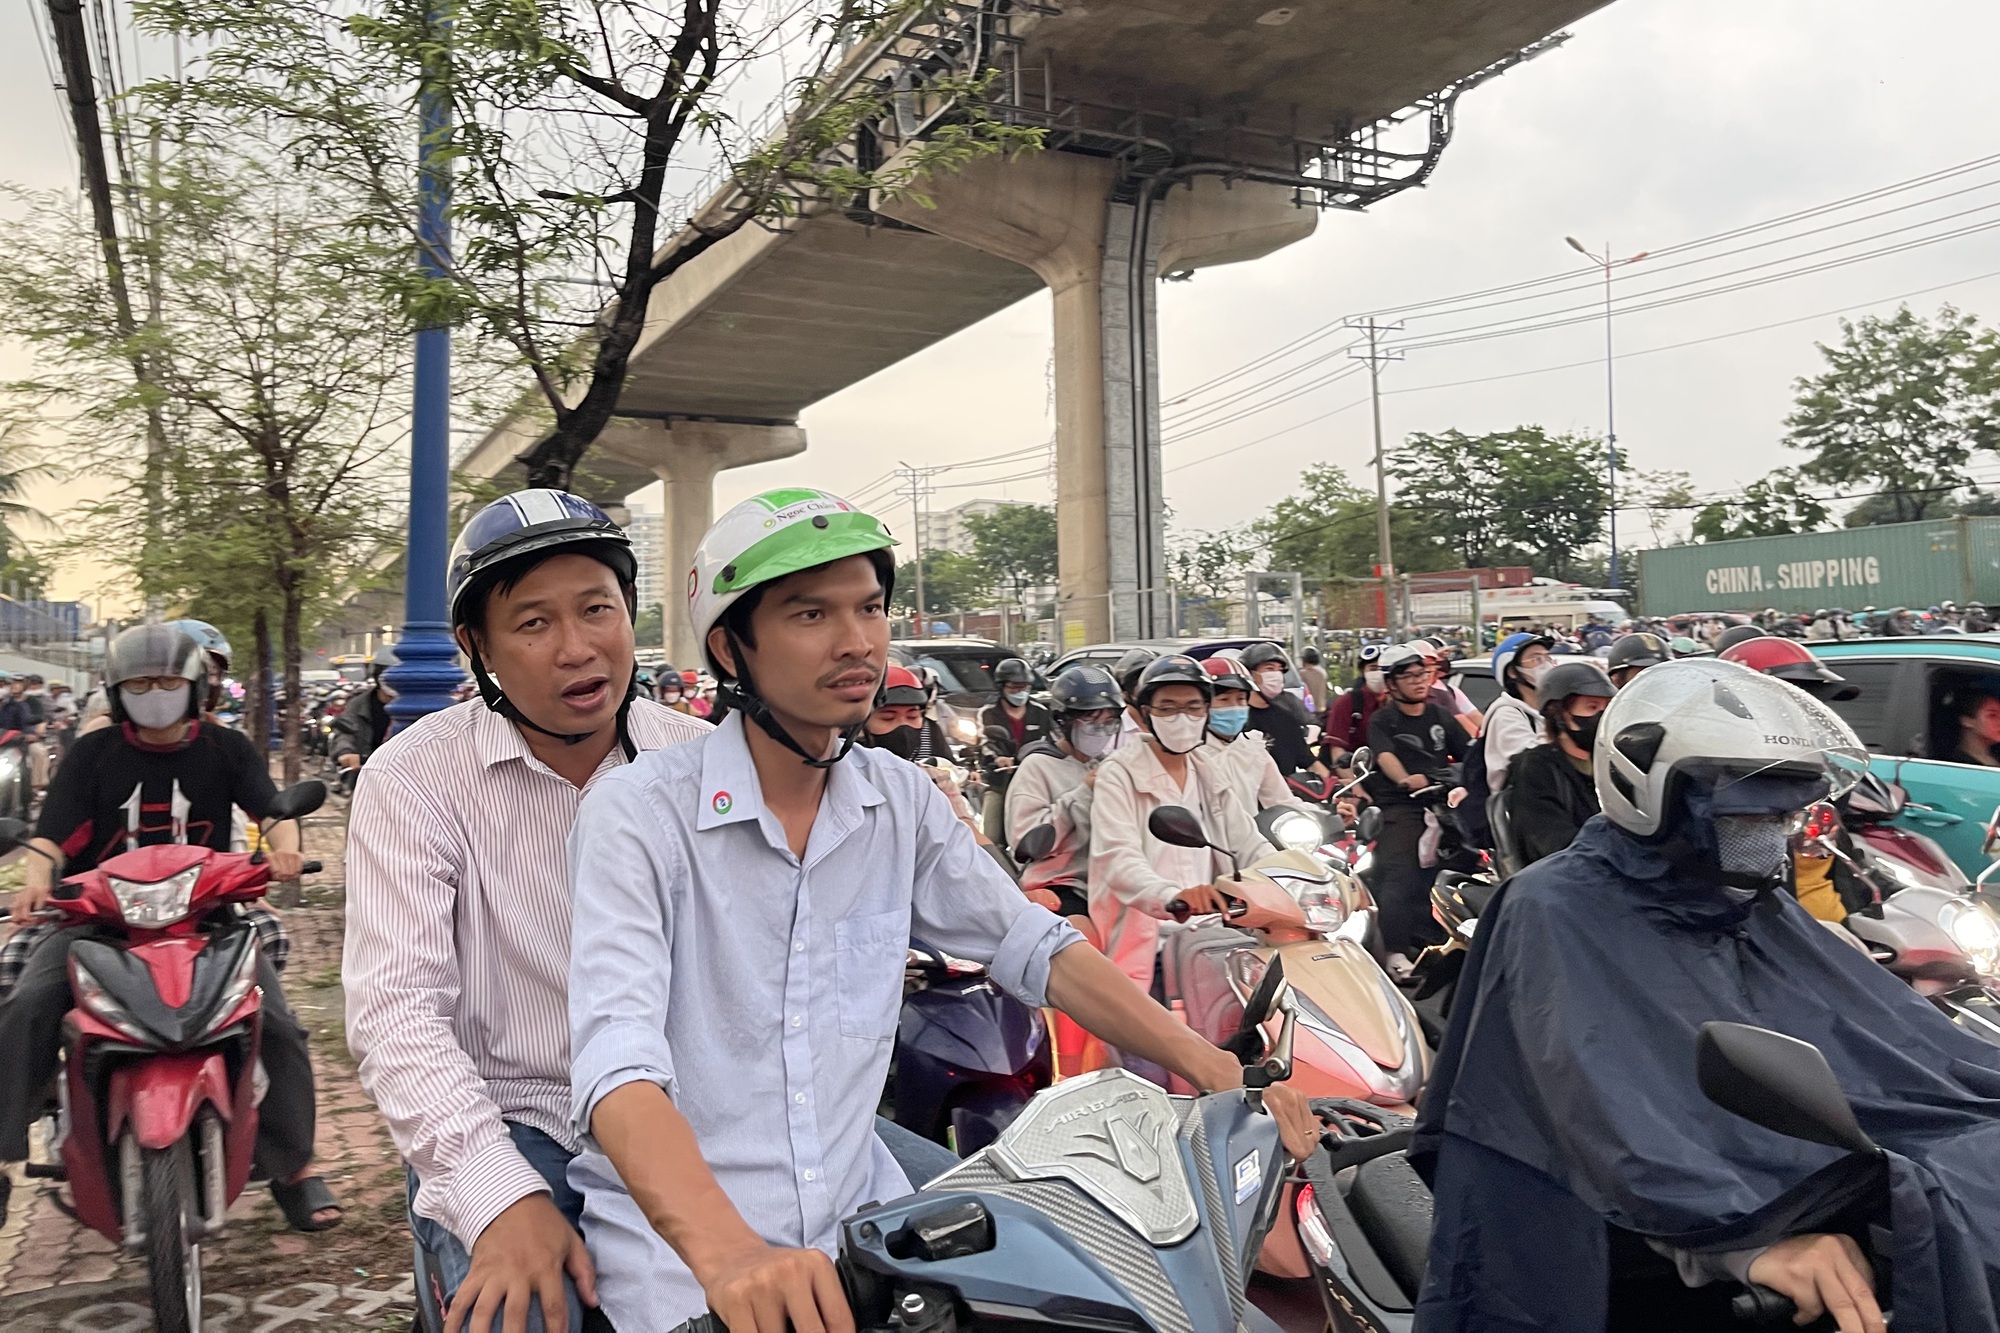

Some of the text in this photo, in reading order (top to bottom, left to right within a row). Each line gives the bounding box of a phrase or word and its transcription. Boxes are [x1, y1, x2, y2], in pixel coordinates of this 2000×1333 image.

[1706, 556, 1881, 594] CHINA SHIPPING
[1763, 734, 1817, 749] HONDA
[1044, 1090, 1149, 1134] AIR BLADE
